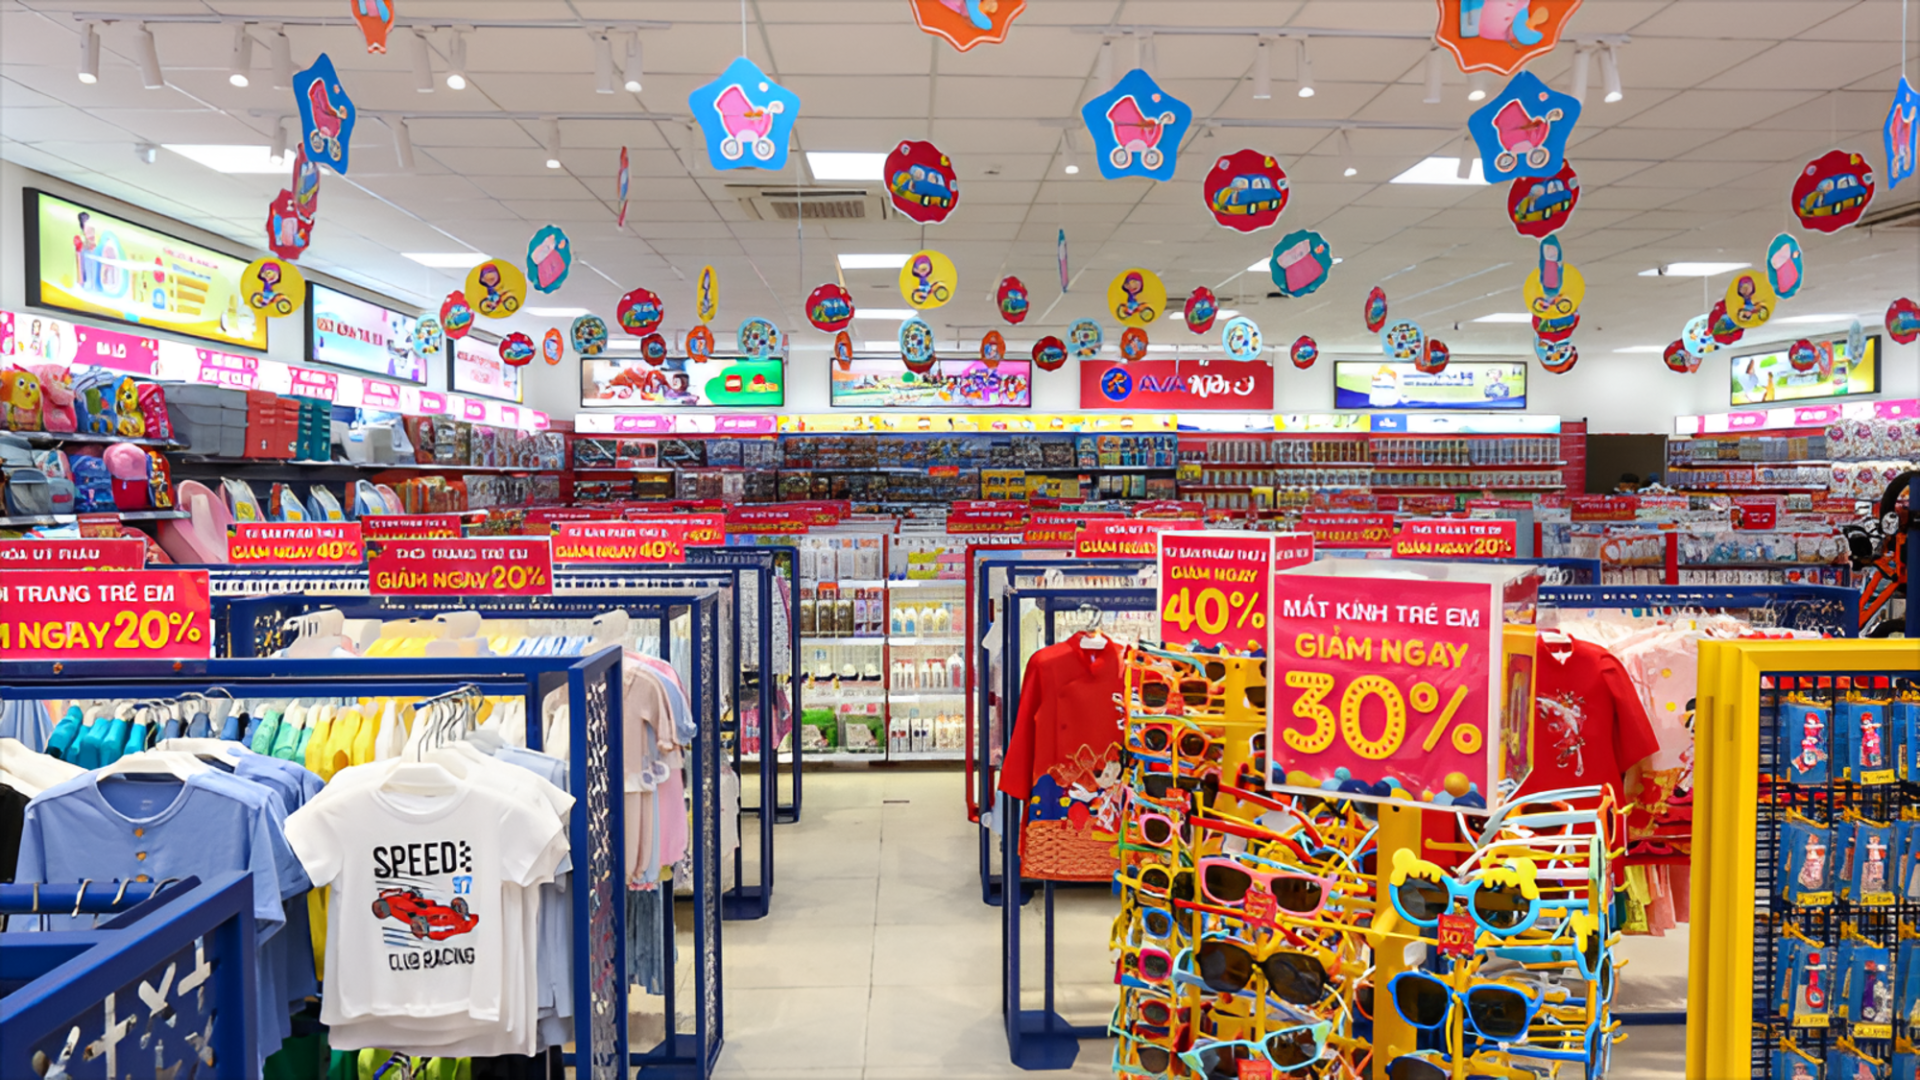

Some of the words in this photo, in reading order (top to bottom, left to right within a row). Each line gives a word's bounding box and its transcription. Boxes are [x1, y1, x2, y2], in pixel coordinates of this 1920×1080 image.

[15, 584, 91, 603] TRANG
[491, 564, 546, 590] 20%
[1162, 586, 1265, 635] 40%
[1446, 607, 1480, 628] EM
[18, 620, 111, 650] NGAY
[113, 609, 202, 650] 20%
[1380, 638, 1469, 668] NGAY
[1283, 670, 1483, 760] 30%
[372, 840, 457, 879] SPEED
